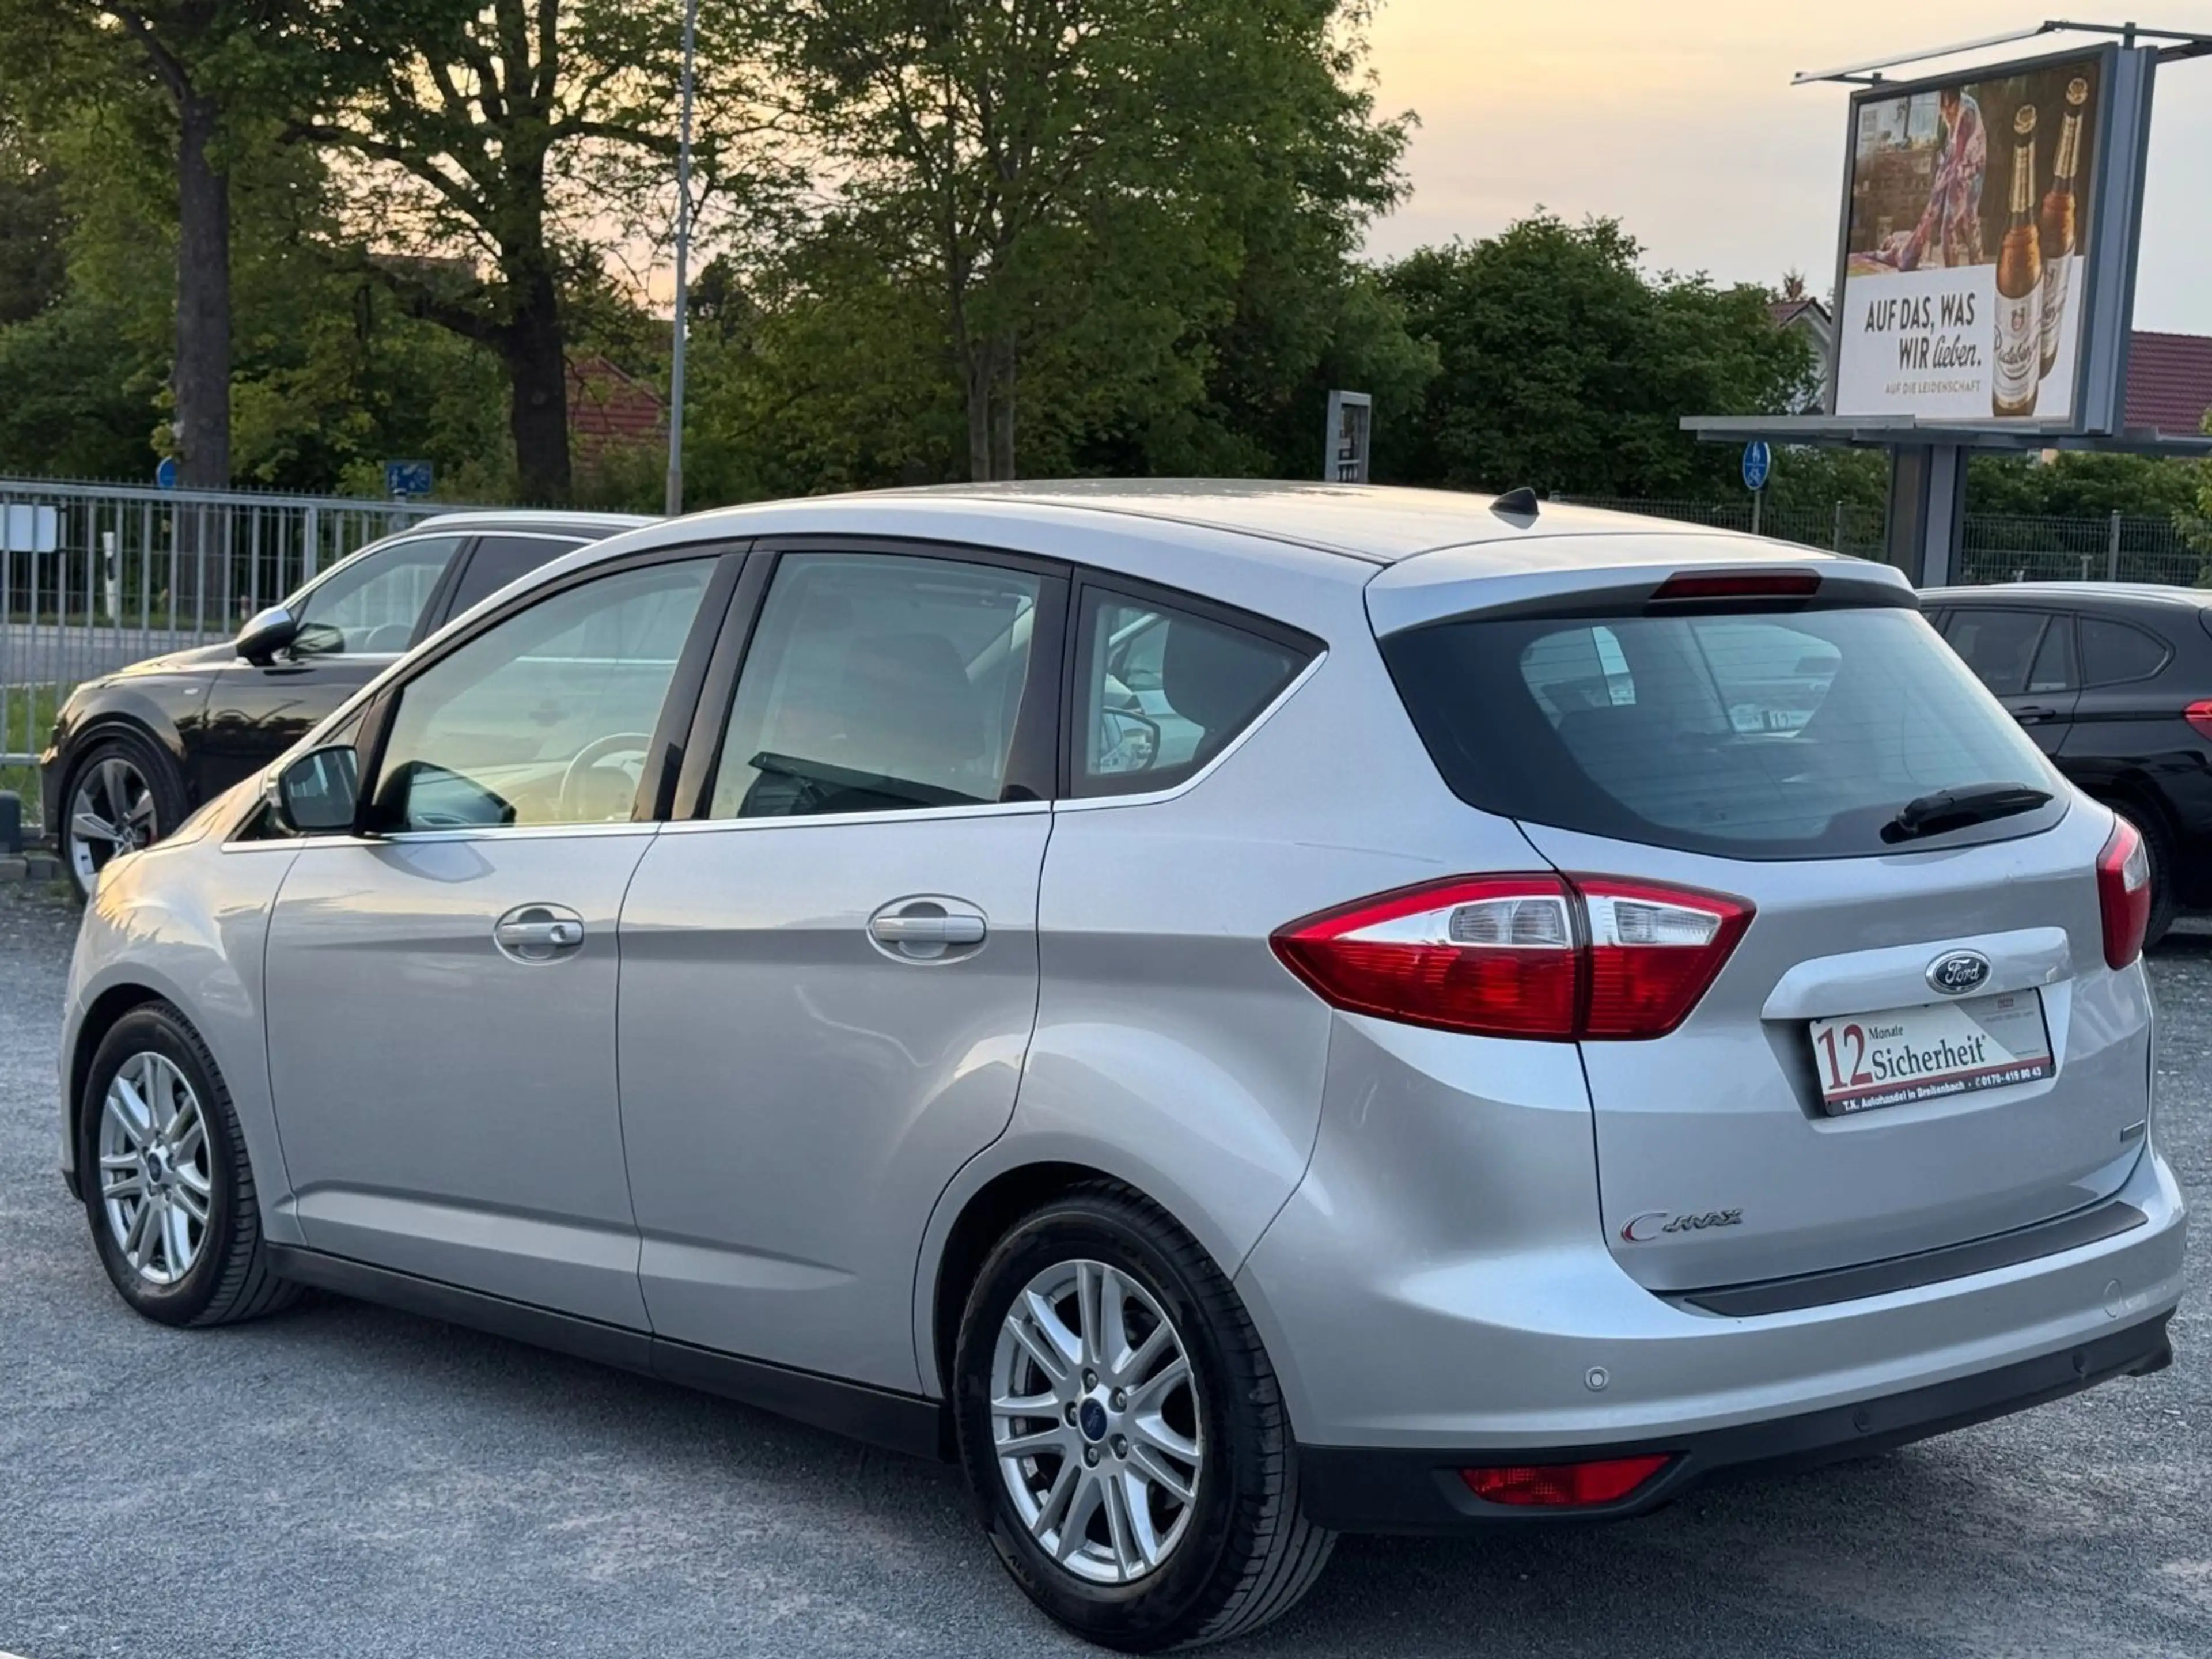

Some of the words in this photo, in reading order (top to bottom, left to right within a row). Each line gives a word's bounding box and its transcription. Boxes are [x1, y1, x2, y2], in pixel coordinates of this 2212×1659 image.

[1864, 298, 1897, 333] AUF
[1900, 296, 1935, 335] DAS,
[1941, 292, 1976, 328] WAS
[1899, 336, 1930, 370] WIR
[1932, 334, 1982, 369] lieben.
[1885, 382, 1901, 395] AUF
[1902, 381, 1917, 395] DIE
[1918, 380, 1980, 393] LEIDENSCHAFT
[1945, 959, 1979, 984] Ford
[1869, 1025, 1903, 1040] Monate
[1817, 1024, 1873, 1090] 12
